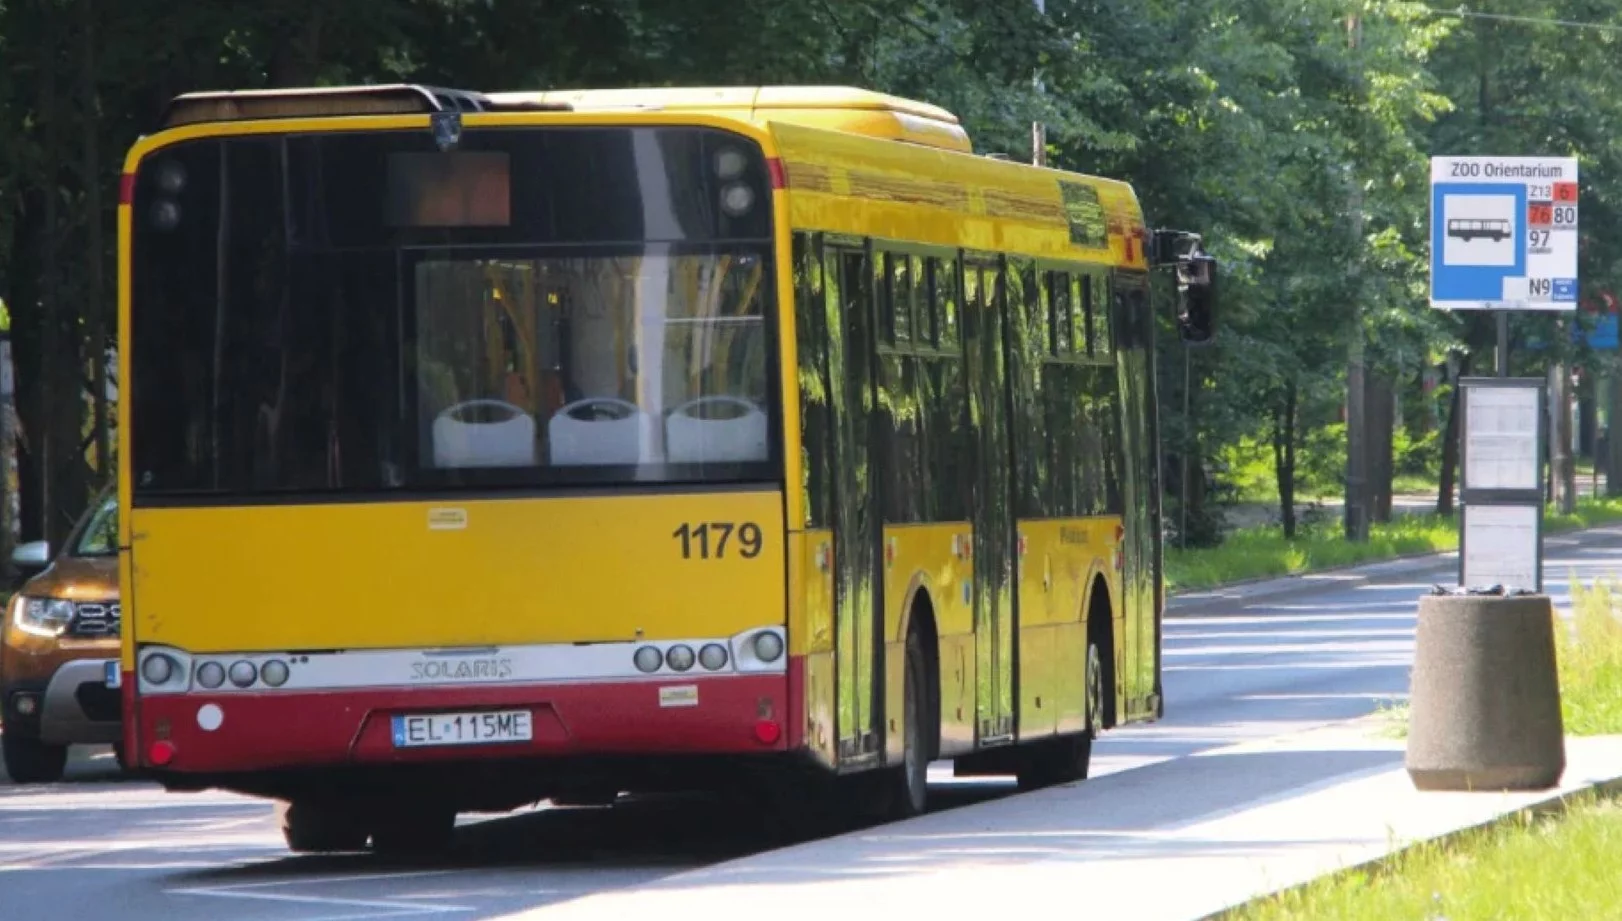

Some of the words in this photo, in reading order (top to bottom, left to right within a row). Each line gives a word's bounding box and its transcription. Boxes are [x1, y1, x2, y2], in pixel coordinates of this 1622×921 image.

[1451, 163, 1480, 177] ZOO
[1484, 163, 1562, 177] Orientarium
[1530, 185, 1551, 197] Z13
[1560, 185, 1569, 200] 6
[1529, 206, 1550, 224] 76
[1554, 207, 1574, 223] 80
[1529, 230, 1550, 246] 97
[1529, 278, 1550, 296] N9
[672, 522, 763, 560] 1179
[409, 659, 512, 680] SOLARIS
